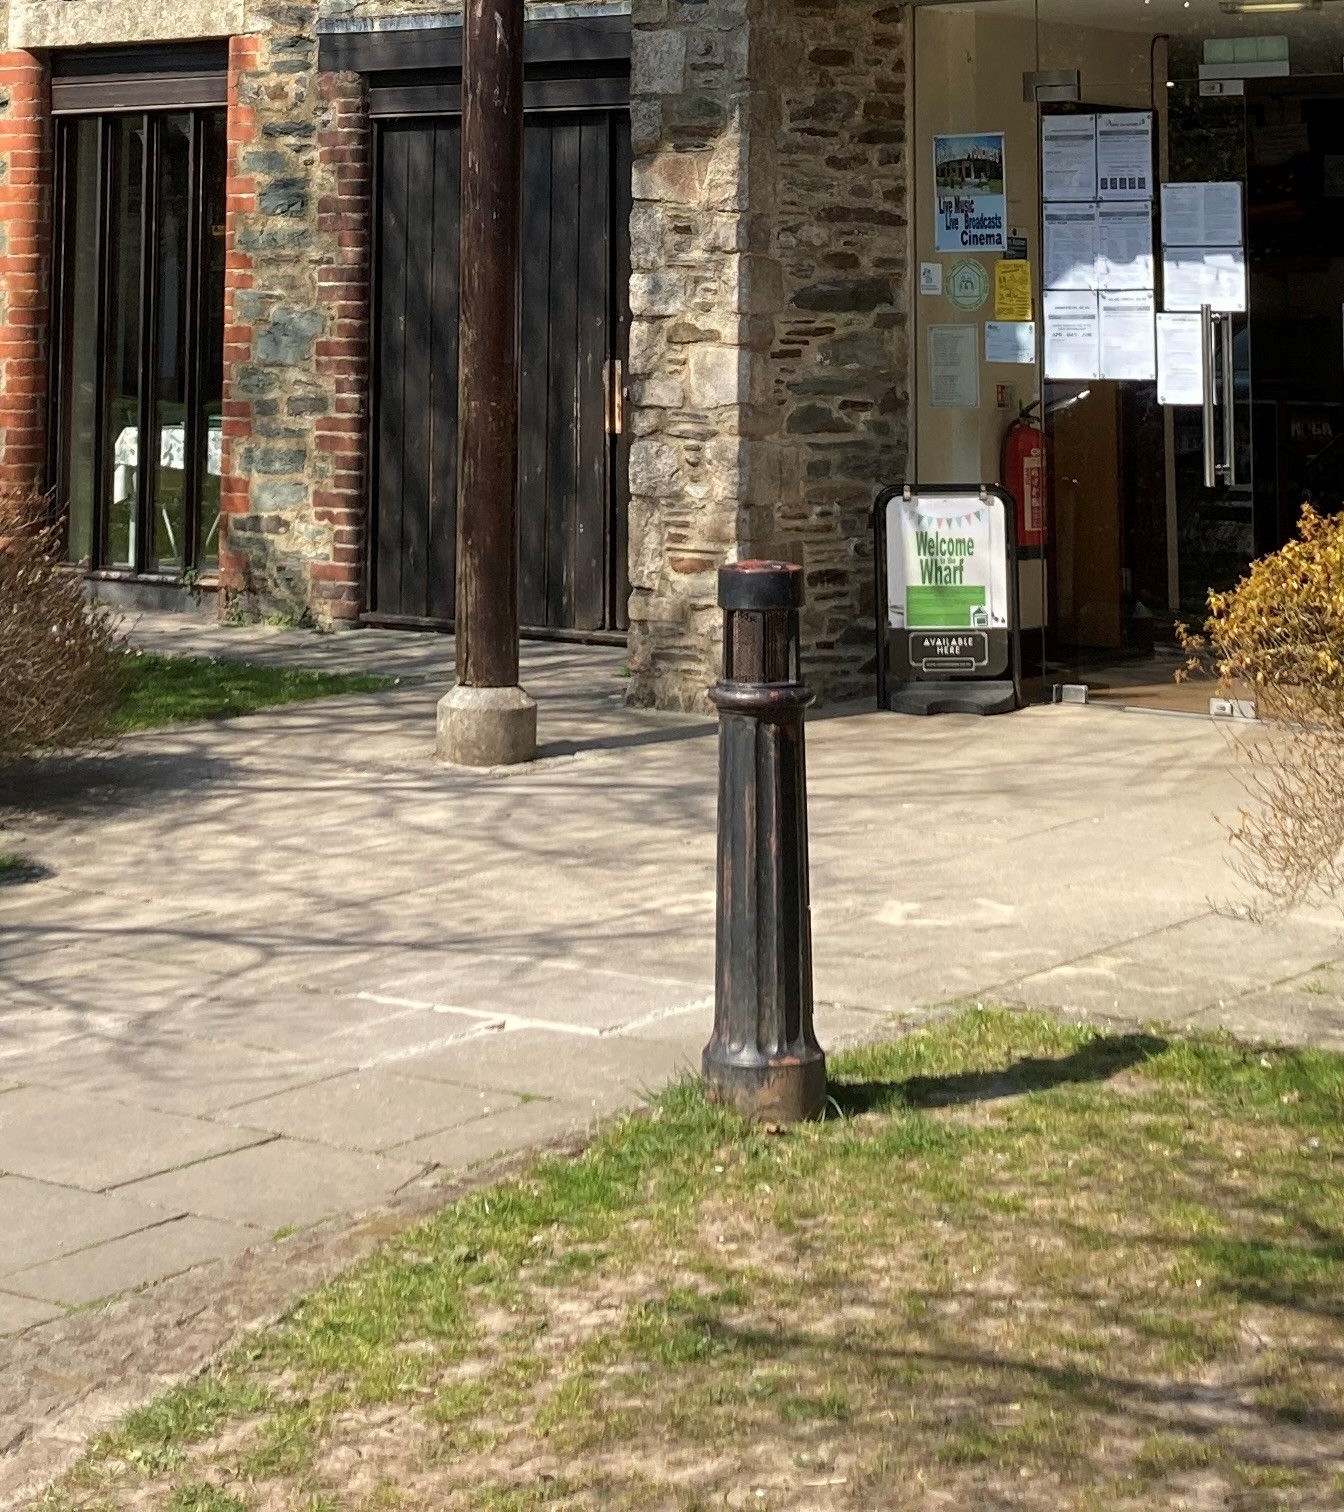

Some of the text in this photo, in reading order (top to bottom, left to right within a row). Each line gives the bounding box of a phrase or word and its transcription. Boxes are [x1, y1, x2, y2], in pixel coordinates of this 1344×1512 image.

[938, 195, 975, 214] Live Music
[945, 212, 1002, 231] Live Broadcasts
[960, 230, 1003, 246] Cinema
[915, 531, 975, 557] Welcome
[919, 558, 965, 585] Wharf
[923, 636, 974, 647] AVAILABLE
[936, 646, 961, 656] HERE
